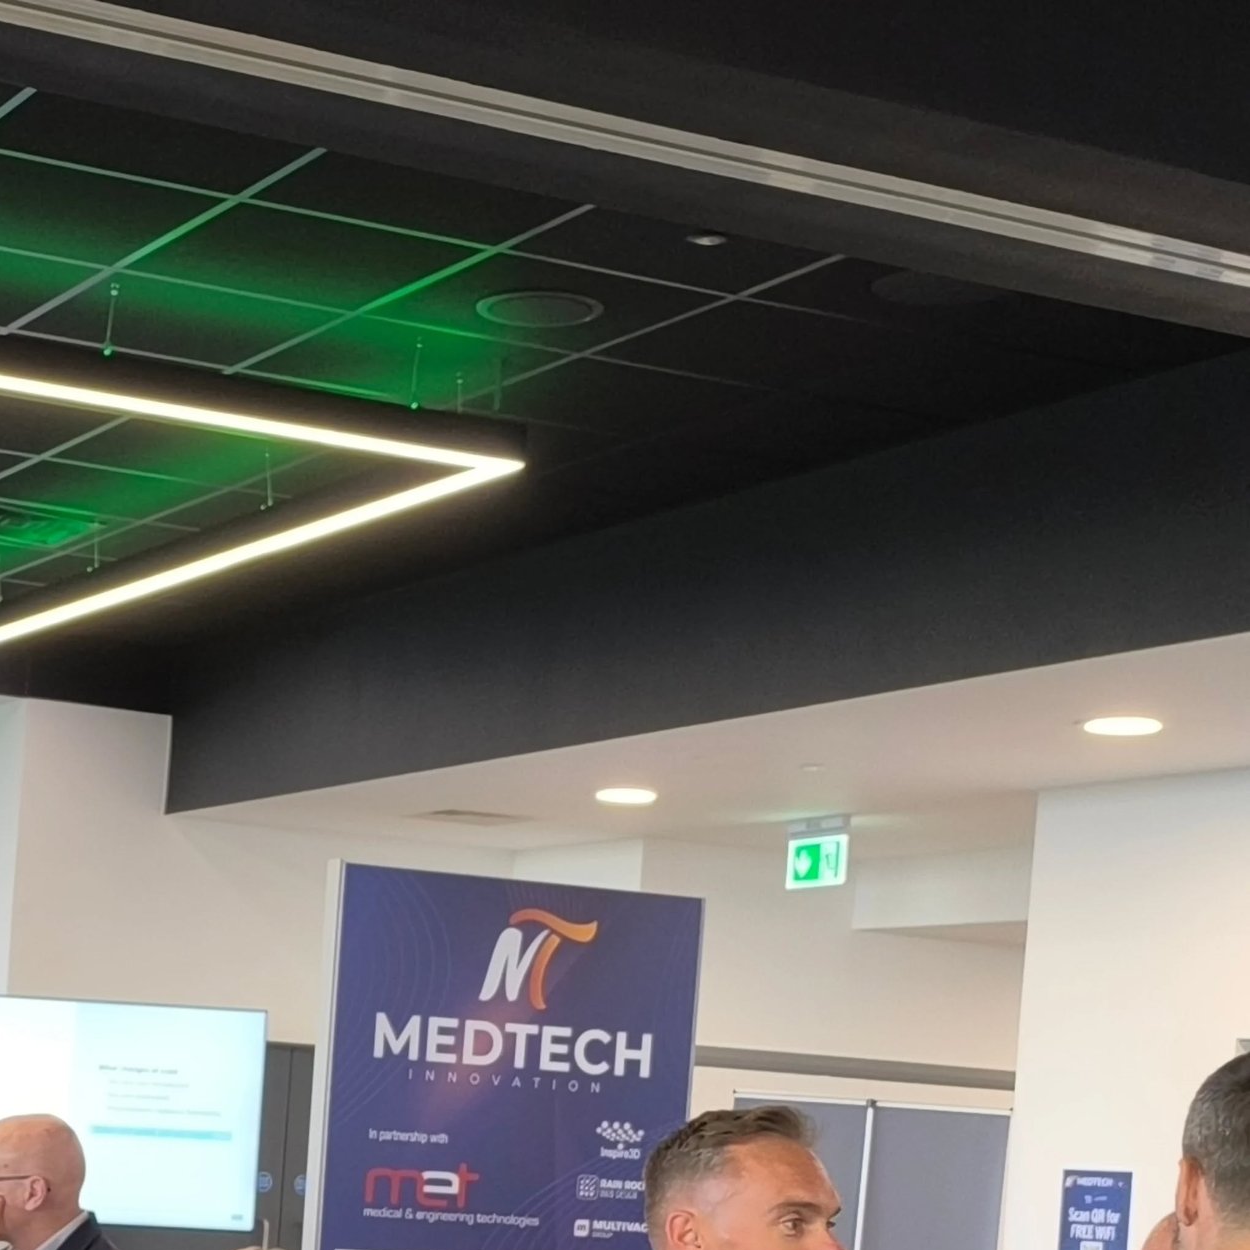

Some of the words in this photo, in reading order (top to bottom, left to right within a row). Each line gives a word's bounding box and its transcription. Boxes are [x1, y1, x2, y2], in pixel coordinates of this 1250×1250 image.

[372, 1011, 653, 1079] MEDTECH
[408, 1068, 602, 1094] INNOVATION
[368, 1128, 377, 1140] In
[379, 1129, 428, 1144] partnership
[430, 1132, 448, 1144] with
[363, 1207, 402, 1219] medical
[404, 1208, 414, 1220] &
[415, 1210, 475, 1226] engineering
[476, 1213, 540, 1228] technologies
[1068, 1206, 1090, 1222] Scan
[1091, 1208, 1105, 1224] QR
[1106, 1209, 1121, 1224] for
[592, 1220, 649, 1233] MULTIVAC
[1069, 1223, 1094, 1240] FREE
